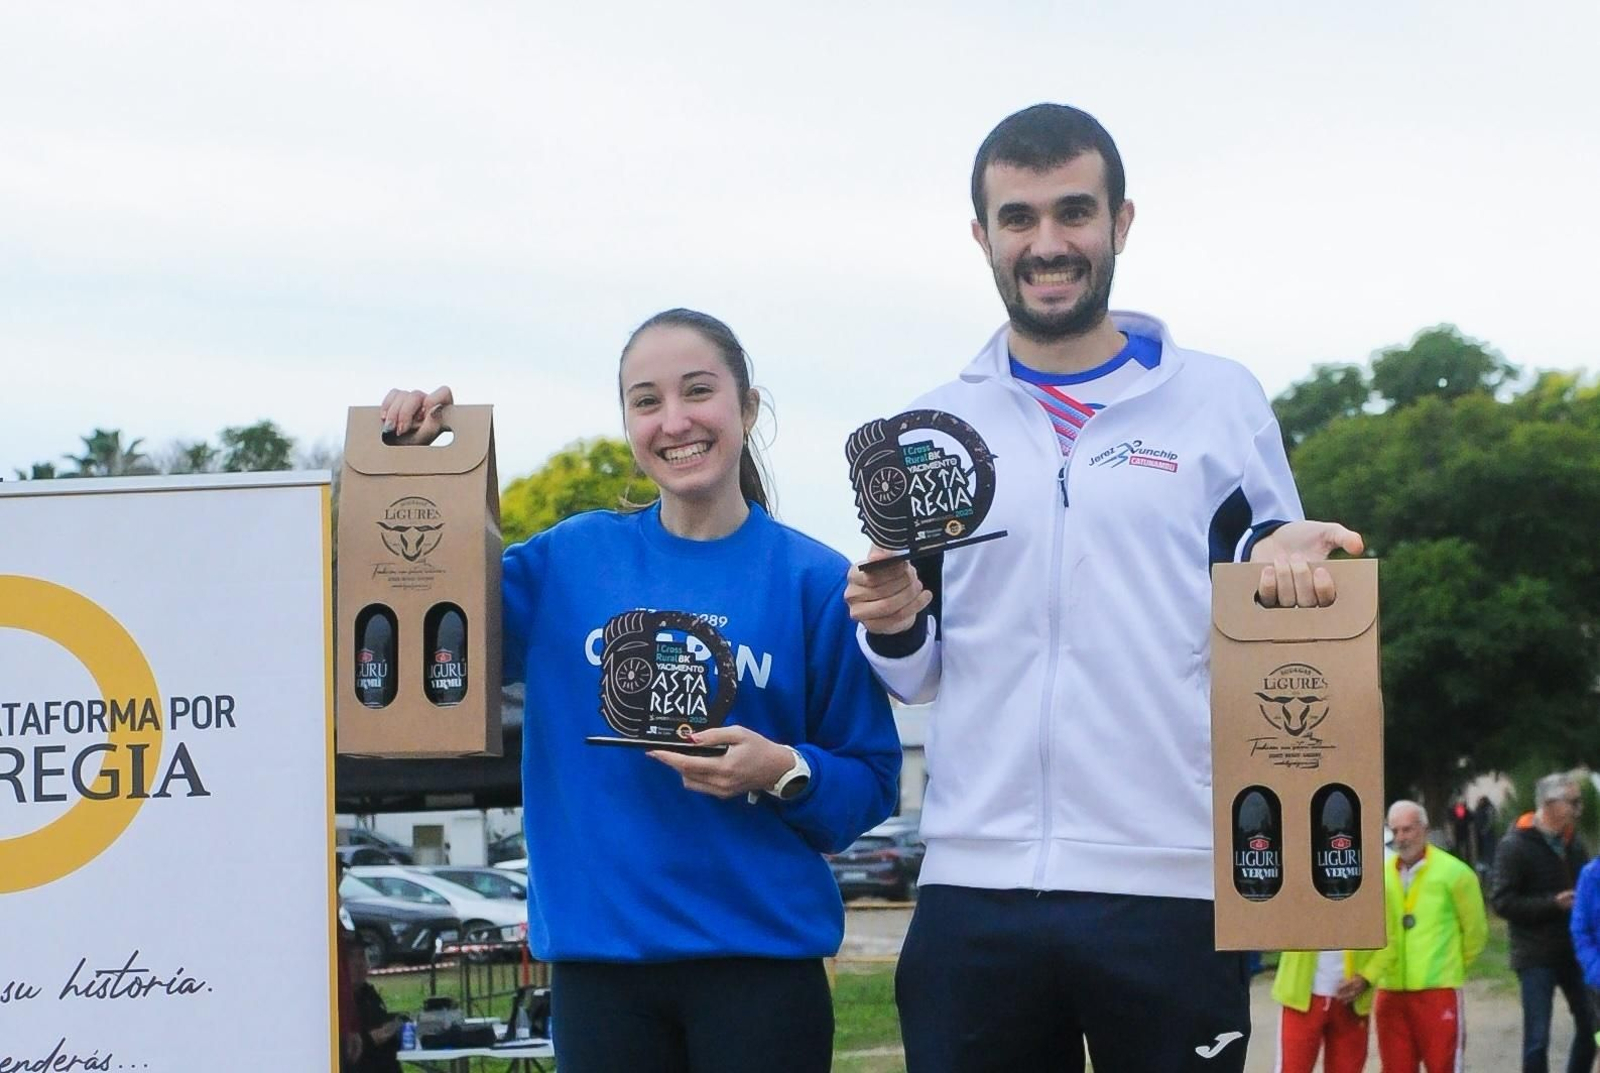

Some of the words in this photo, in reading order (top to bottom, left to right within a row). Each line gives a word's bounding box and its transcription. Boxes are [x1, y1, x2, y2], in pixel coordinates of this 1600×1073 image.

[905, 453, 928, 466] Rural
[907, 458, 958, 474] YACIMIENTO
[908, 466, 966, 495] ASTA
[911, 487, 973, 517] REGIA
[655, 662, 705, 674] YACIMIENTO
[656, 653, 678, 662] Rural
[651, 670, 708, 694] ASTA
[0, 697, 161, 737] TAFORMA
[170, 695, 237, 731] POR
[650, 691, 708, 717] REGIA
[0, 742, 212, 804] REGIA
[0, 981, 43, 1003] su
[59, 950, 213, 1001] historia.
